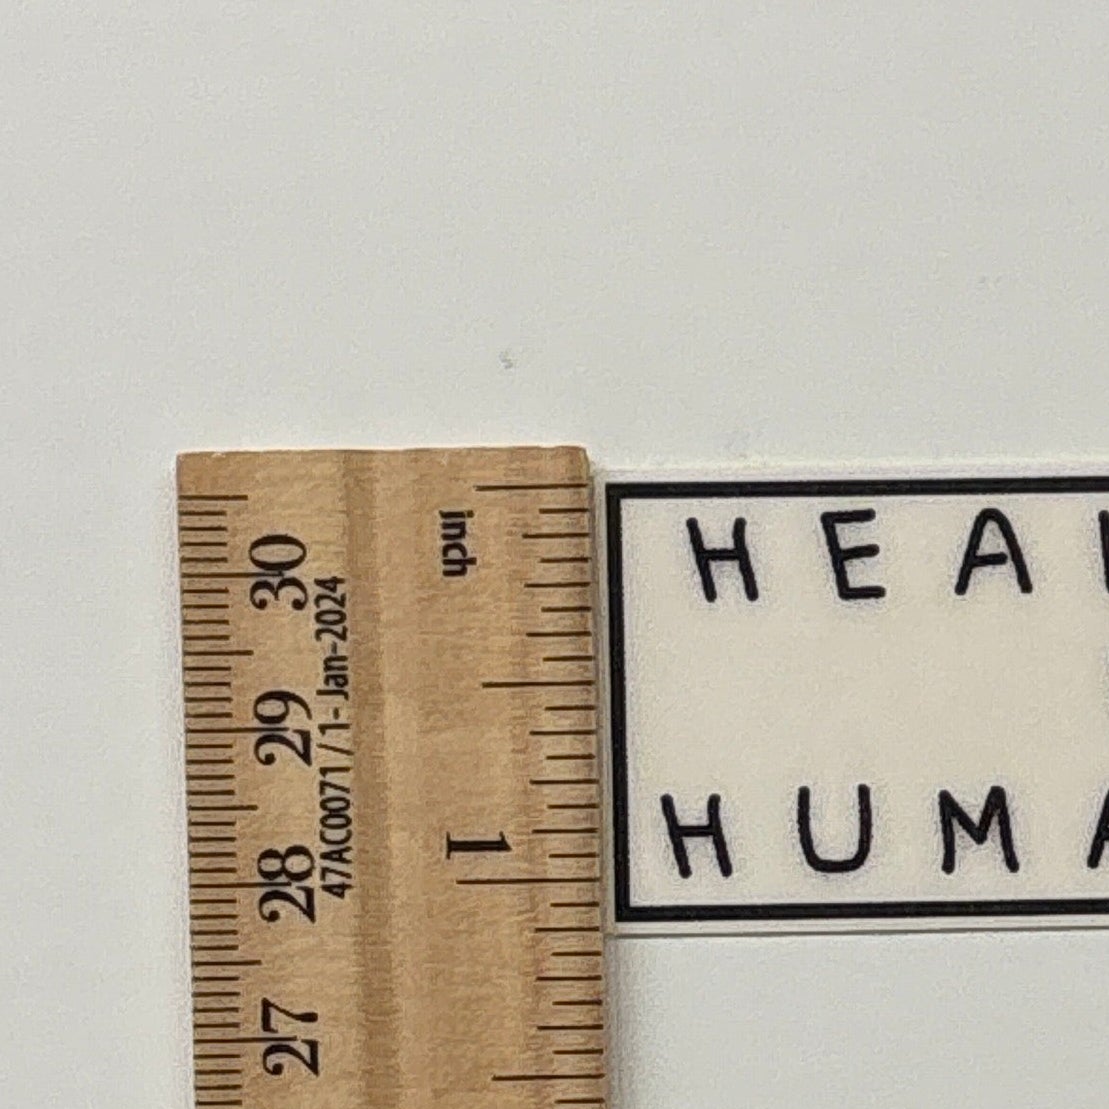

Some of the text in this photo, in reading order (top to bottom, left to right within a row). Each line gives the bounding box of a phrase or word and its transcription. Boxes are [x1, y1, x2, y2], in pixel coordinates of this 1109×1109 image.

[248, 533, 308, 611] 30
[438, 509, 478, 578] inch
[252, 689, 313, 767] 29
[256, 844, 316, 924] 28
[445, 831, 513, 861] 1
[260, 997, 320, 1078] 27
